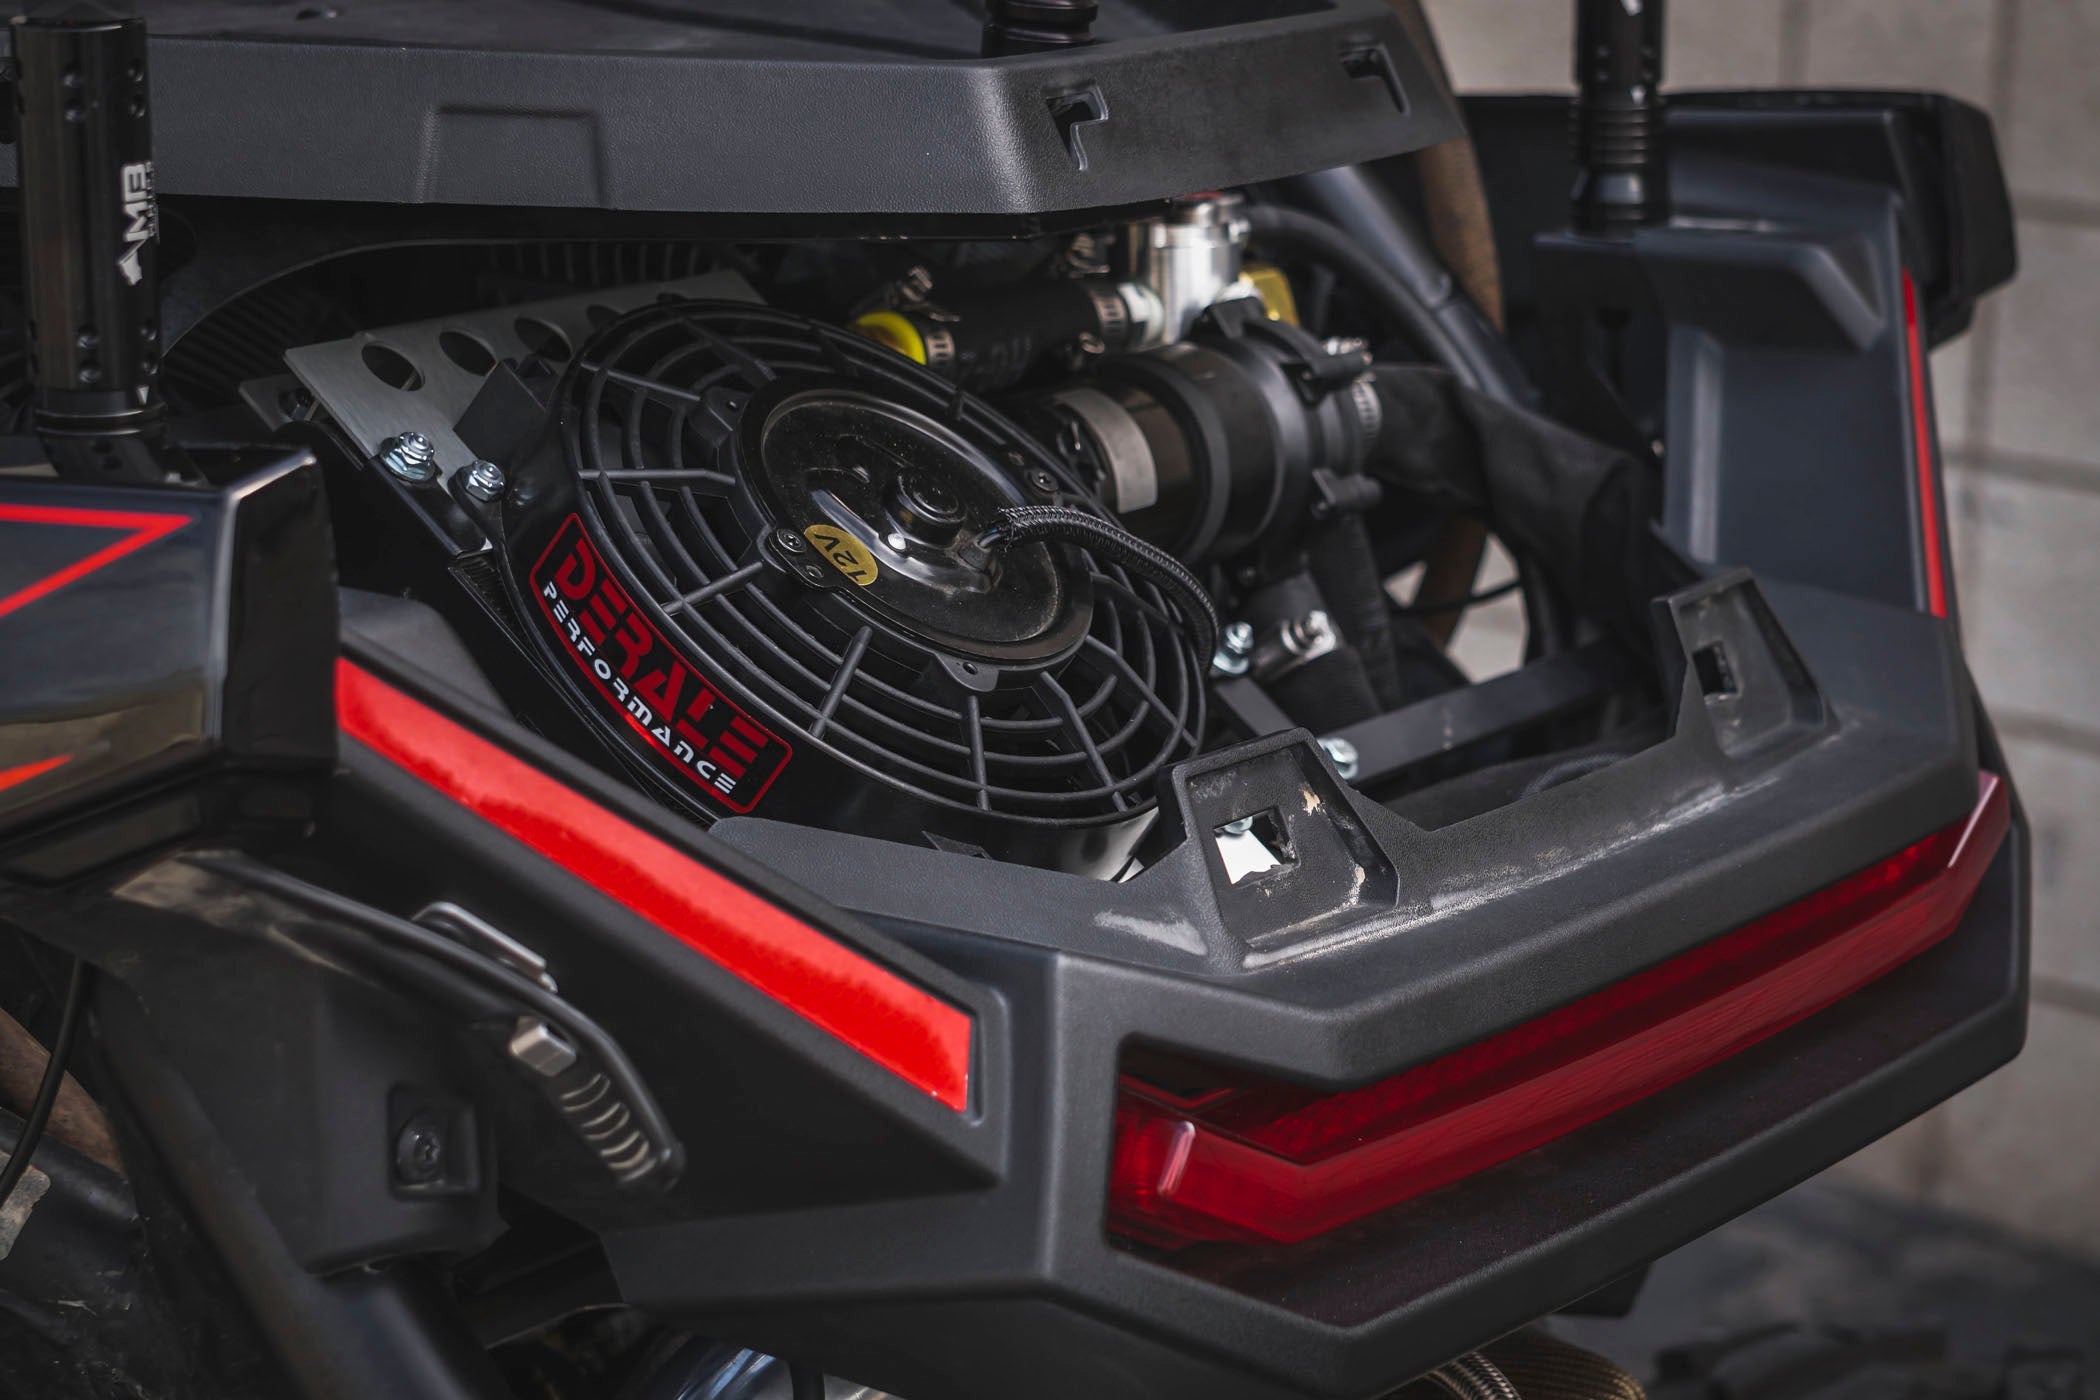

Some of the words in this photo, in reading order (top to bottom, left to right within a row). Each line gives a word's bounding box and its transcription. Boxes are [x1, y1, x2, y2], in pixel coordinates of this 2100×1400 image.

[554, 537, 769, 779] DERALE
[813, 533, 868, 582] 12V
[543, 580, 737, 795] PERFORMANCE
